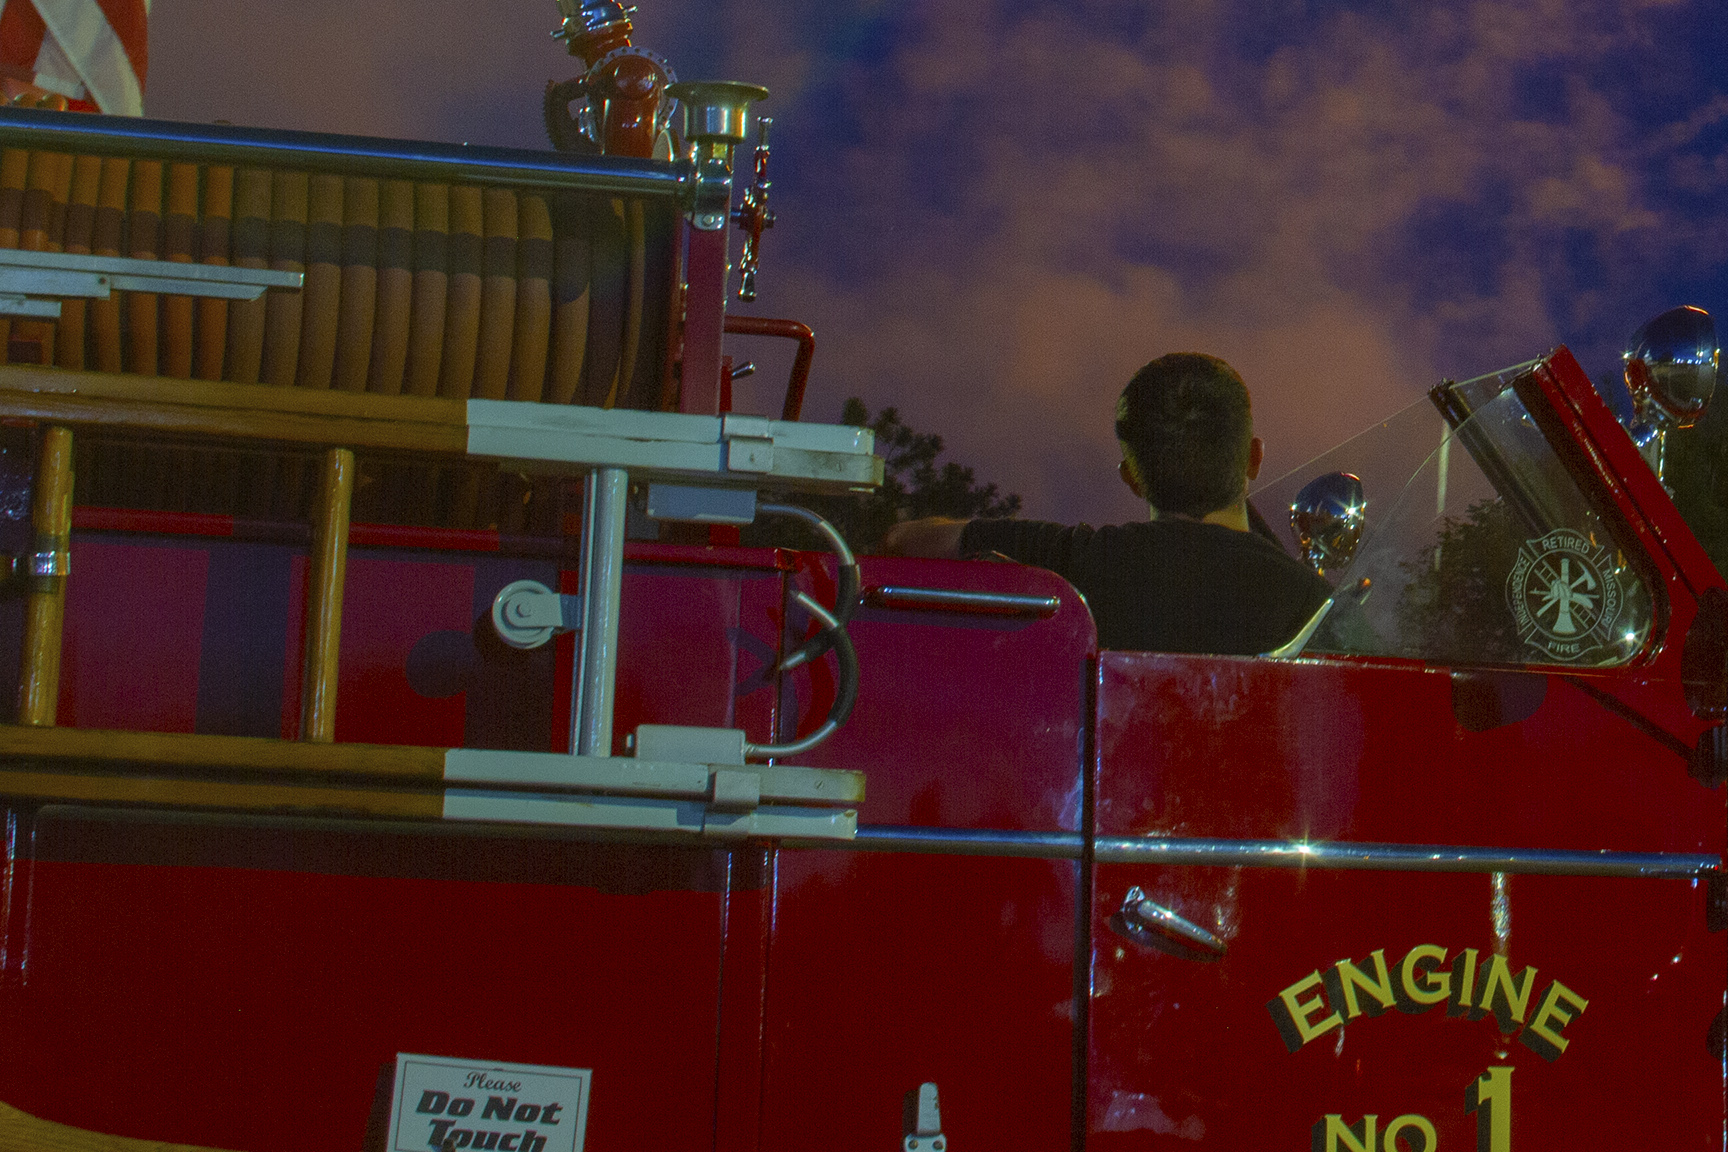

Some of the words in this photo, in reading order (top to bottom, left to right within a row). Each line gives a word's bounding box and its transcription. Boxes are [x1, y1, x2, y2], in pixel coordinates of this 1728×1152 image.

[1541, 535, 1590, 555] RETIRED
[1510, 556, 1530, 624] INDEPENDENCE
[1602, 568, 1618, 628] MISSOURI
[1547, 640, 1581, 654] FIRE
[1277, 943, 1590, 1055] ENGINE
[463, 1071, 523, 1093] Please
[415, 1089, 476, 1117] Do
[480, 1095, 564, 1126] Not
[1477, 1065, 1516, 1152] 1
[427, 1118, 549, 1152] Touch
